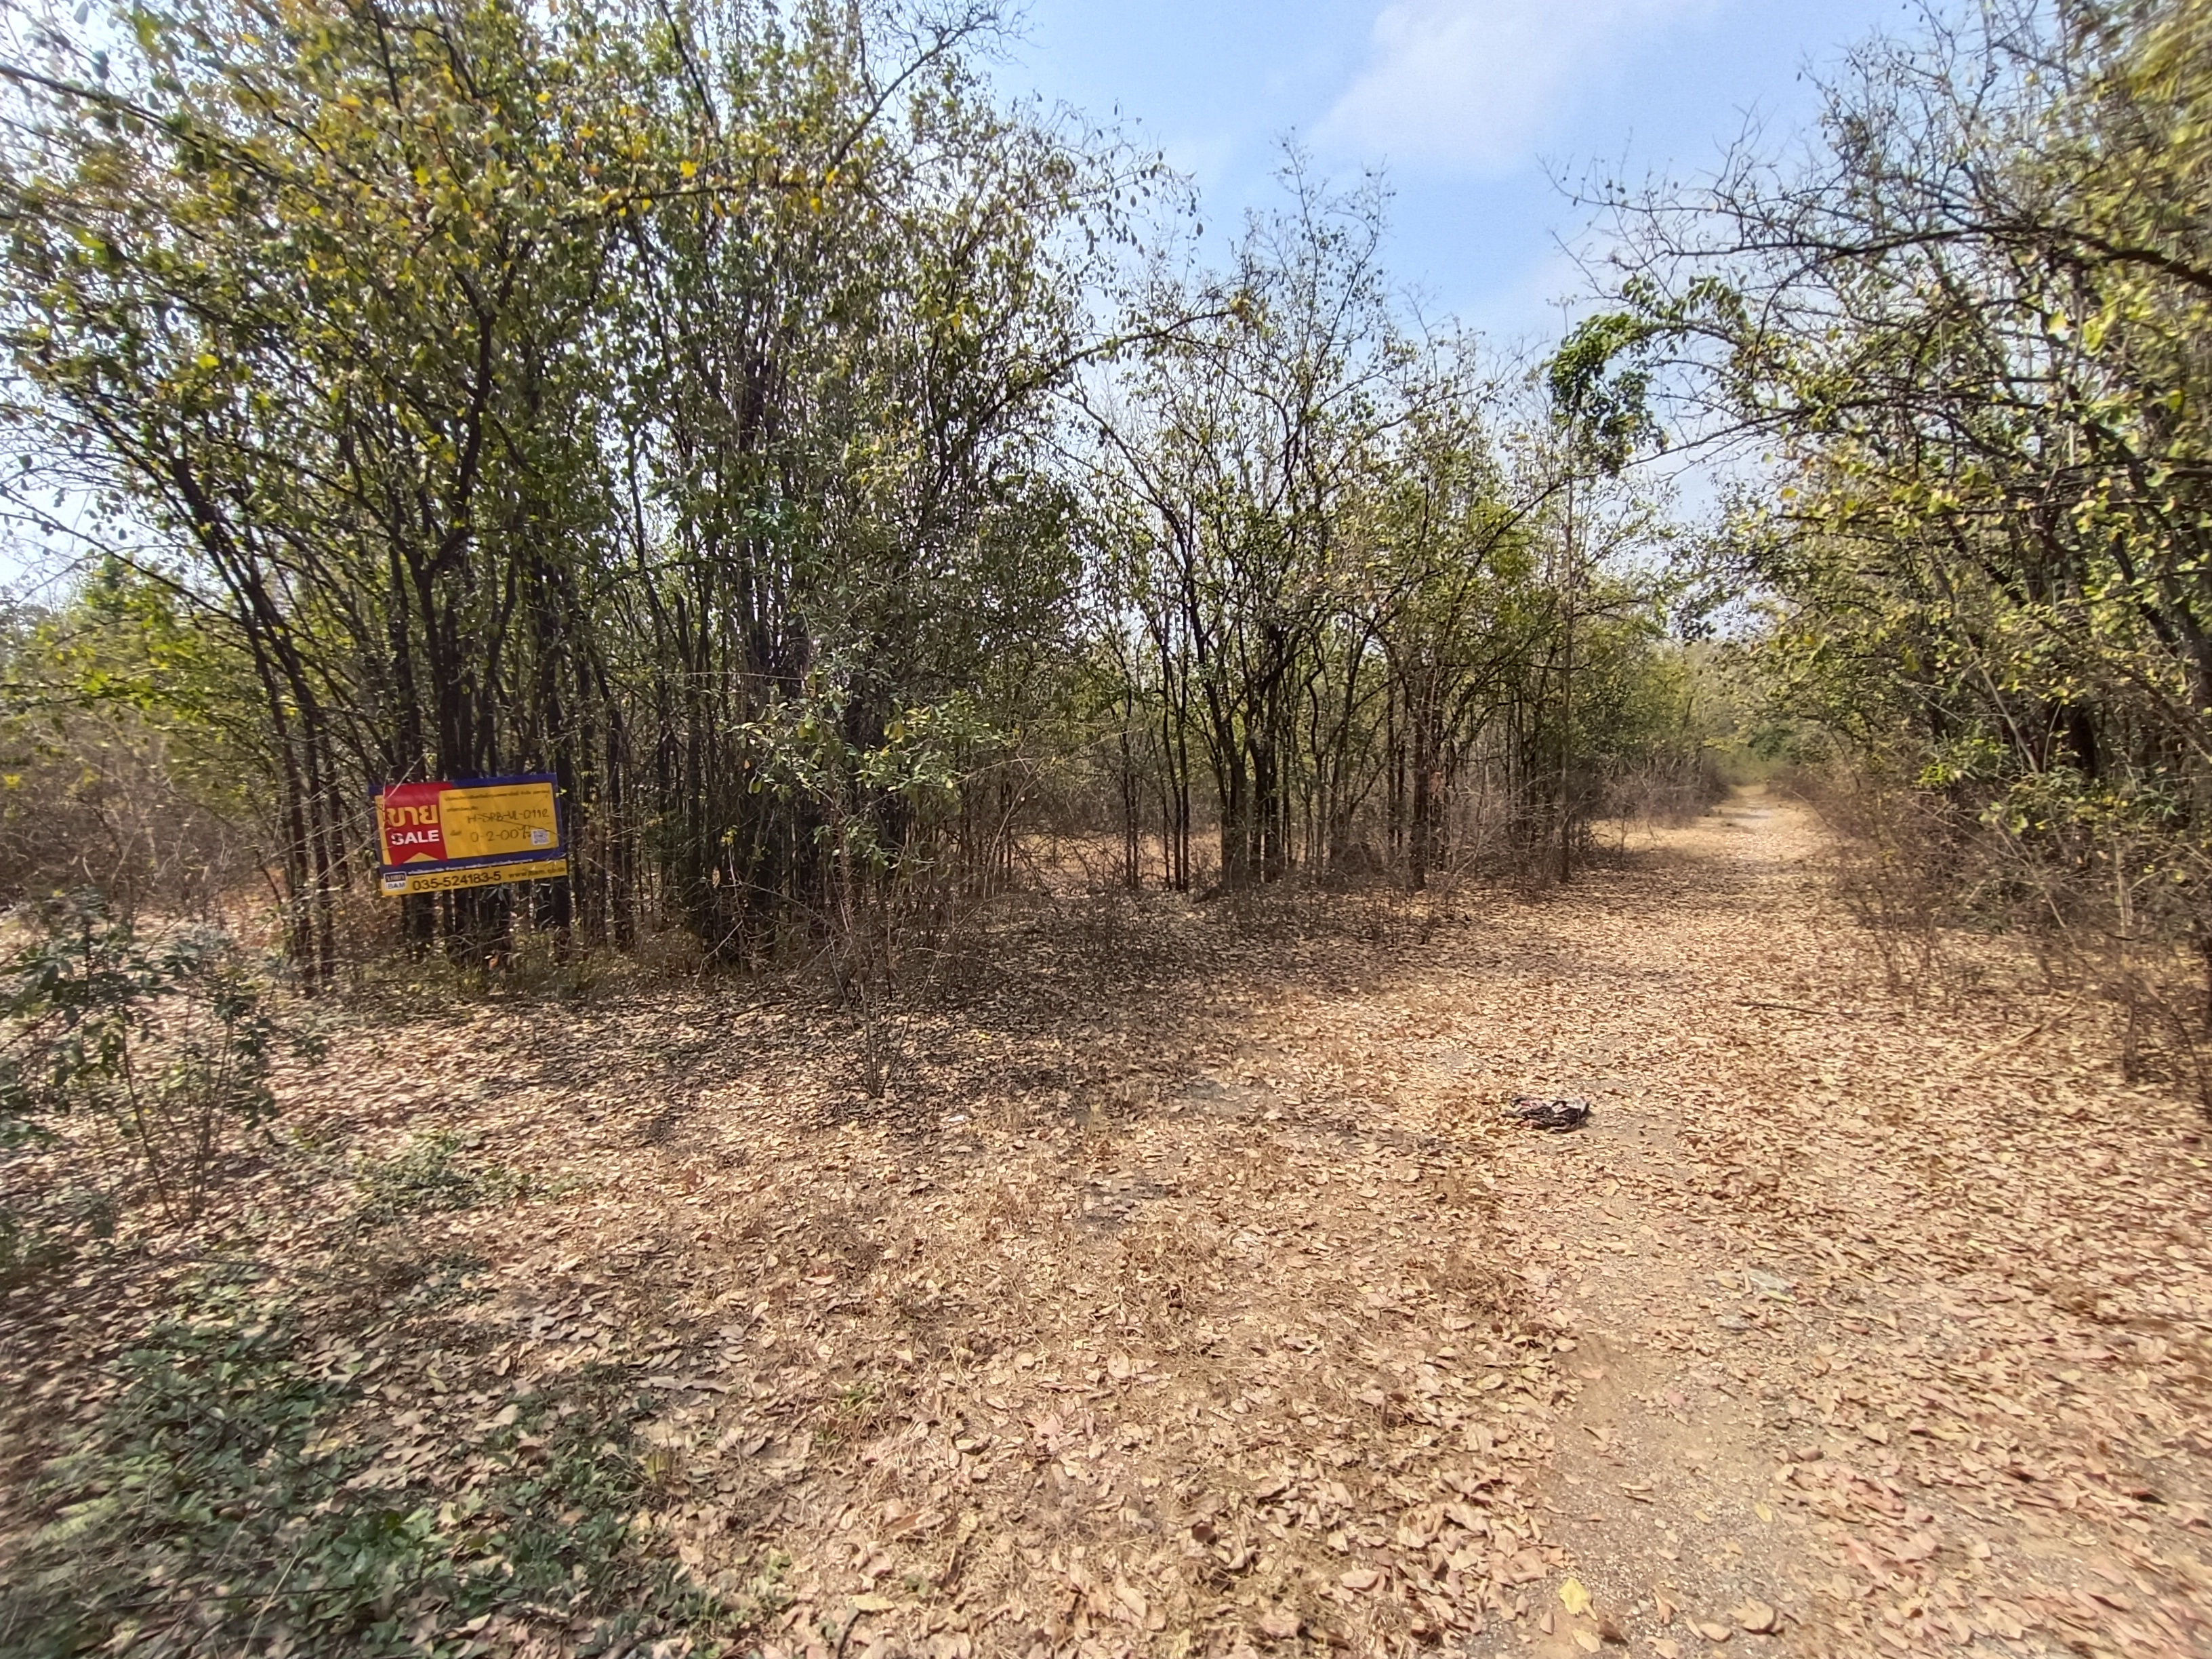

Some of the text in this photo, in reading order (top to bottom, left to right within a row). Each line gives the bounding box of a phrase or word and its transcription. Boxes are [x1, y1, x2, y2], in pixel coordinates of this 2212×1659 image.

[386, 804, 438, 827] ขาย
[391, 830, 440, 845] SALE
[413, 871, 501, 891] 035-524183-5
